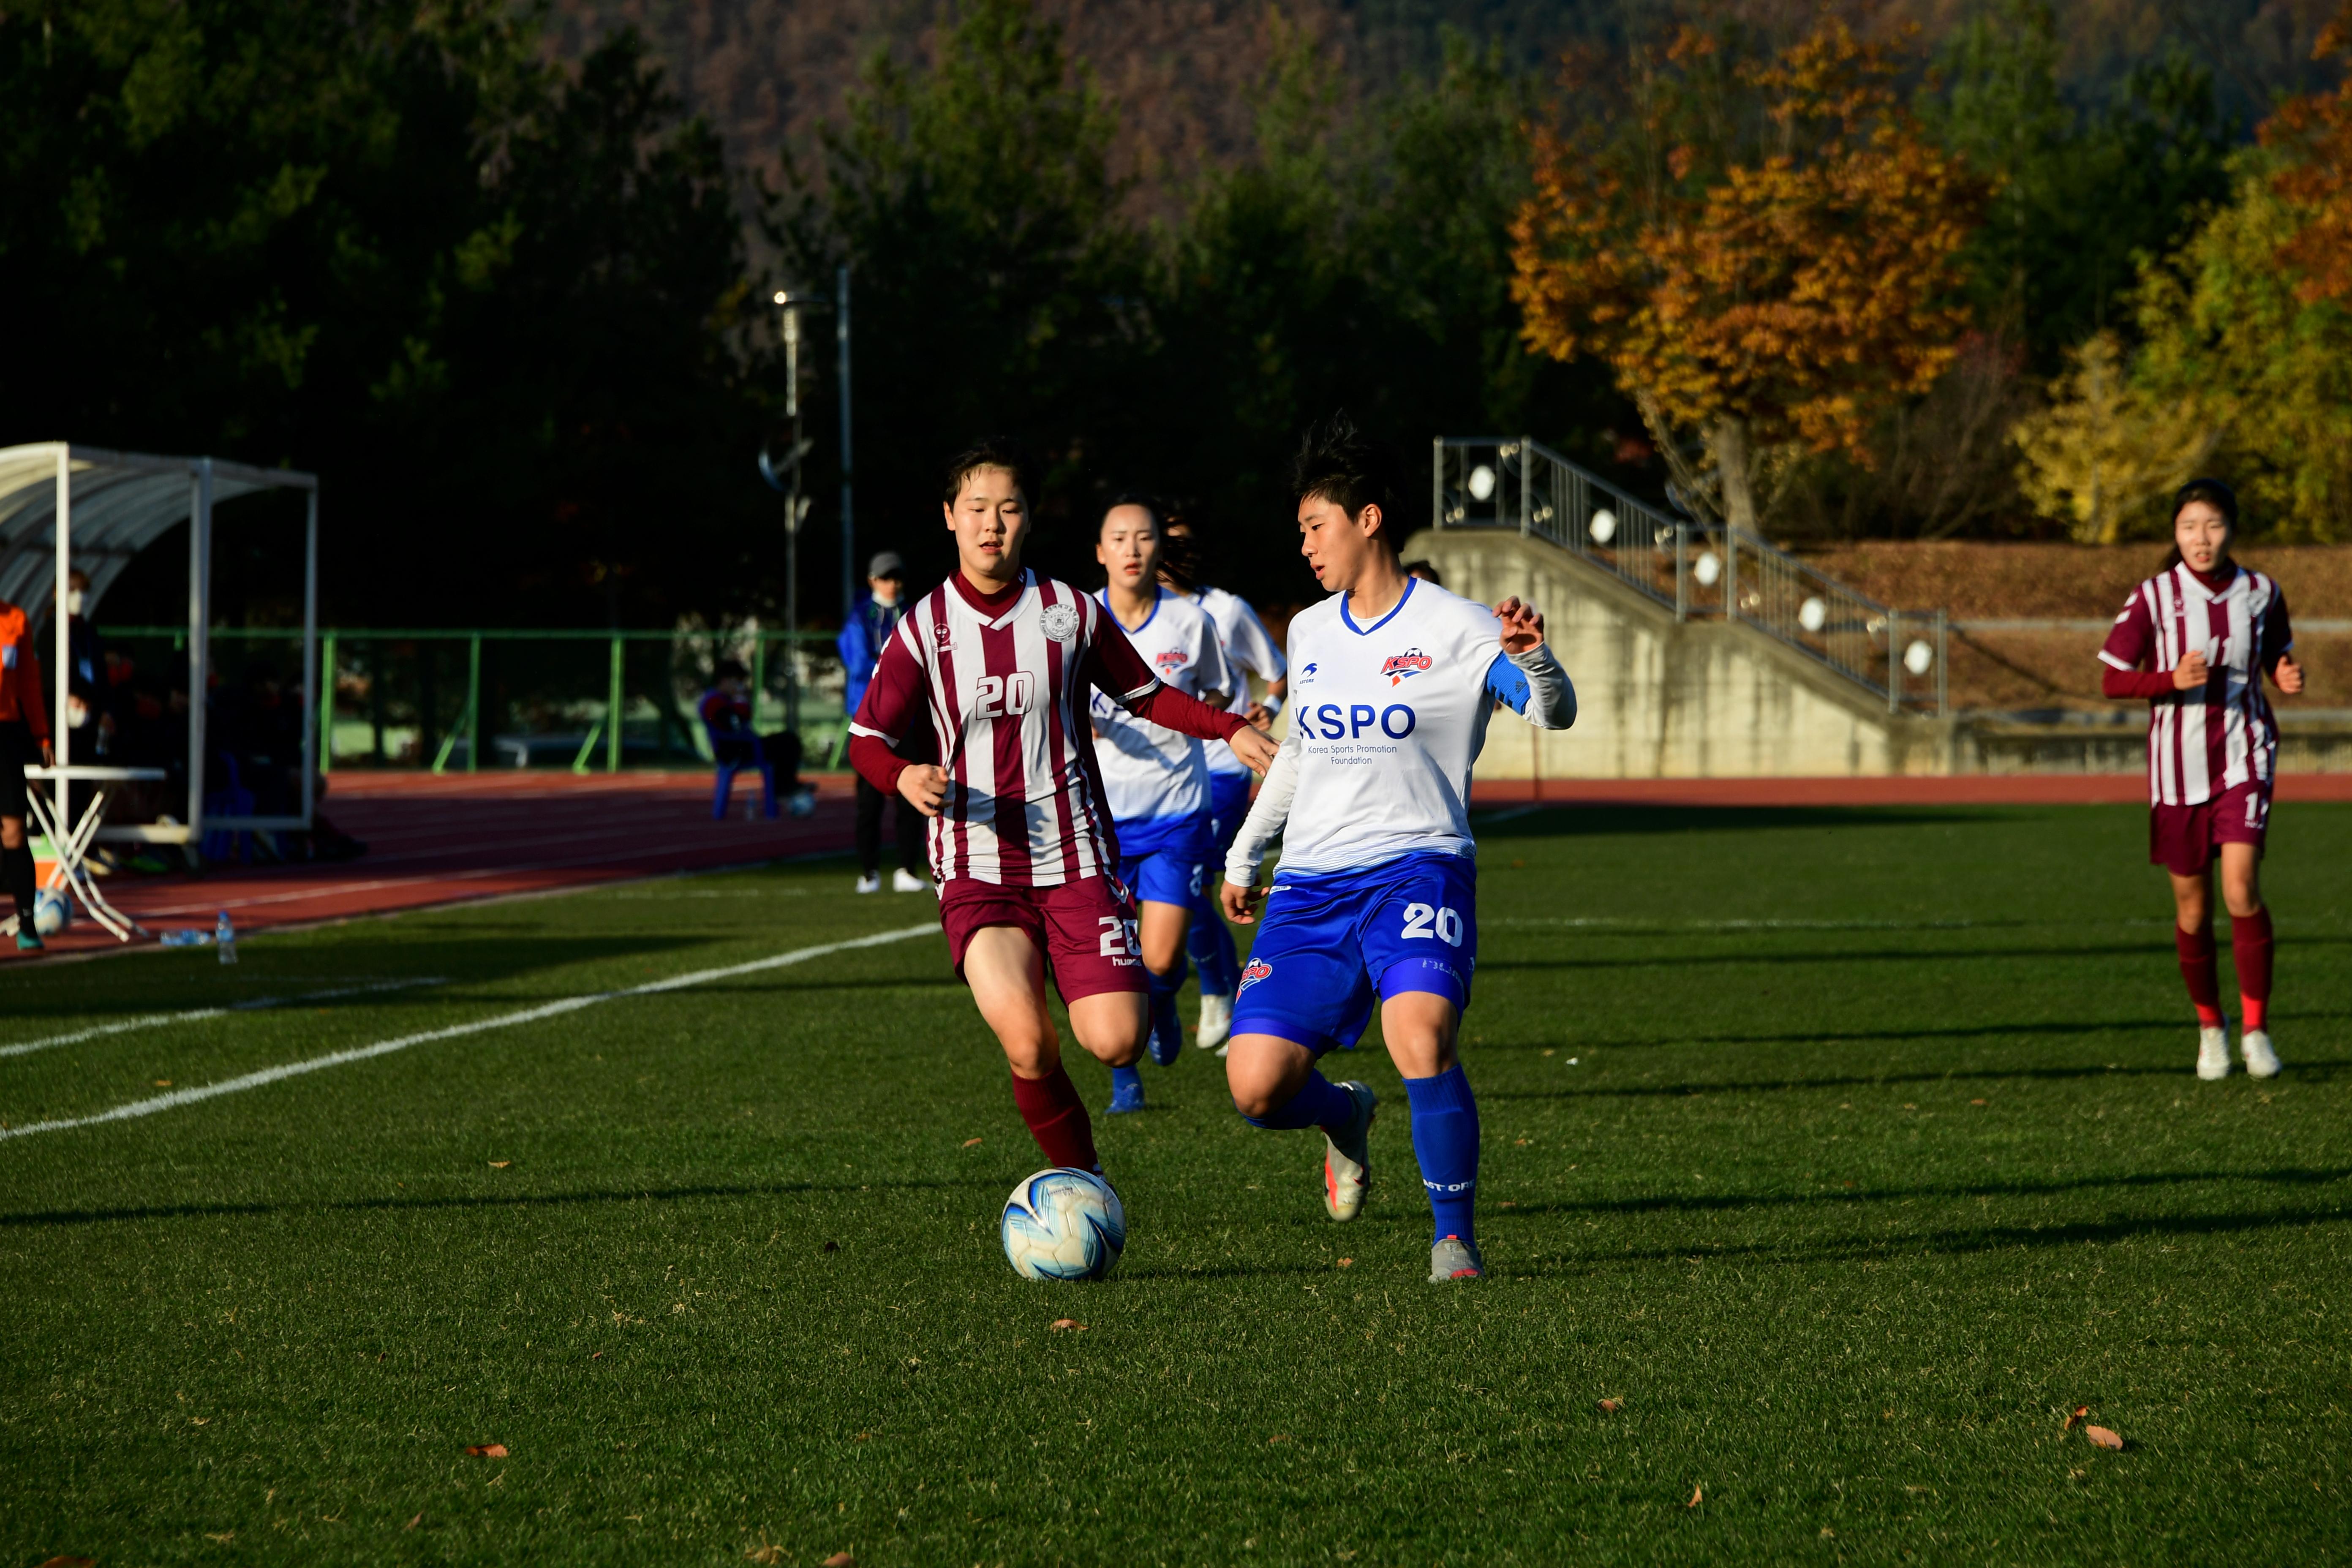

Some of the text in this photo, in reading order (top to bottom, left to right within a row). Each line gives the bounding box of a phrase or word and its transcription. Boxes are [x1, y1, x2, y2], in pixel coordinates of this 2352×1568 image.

[1380, 655, 1433, 674] KSPO
[975, 670, 1035, 721] 20
[1295, 704, 1416, 740] KSPO
[1308, 745, 1397, 755] Korea Sports Promotion
[1331, 756, 1372, 765] Foundation
[1099, 915, 1142, 957] 20
[1401, 903, 1463, 947] 20
